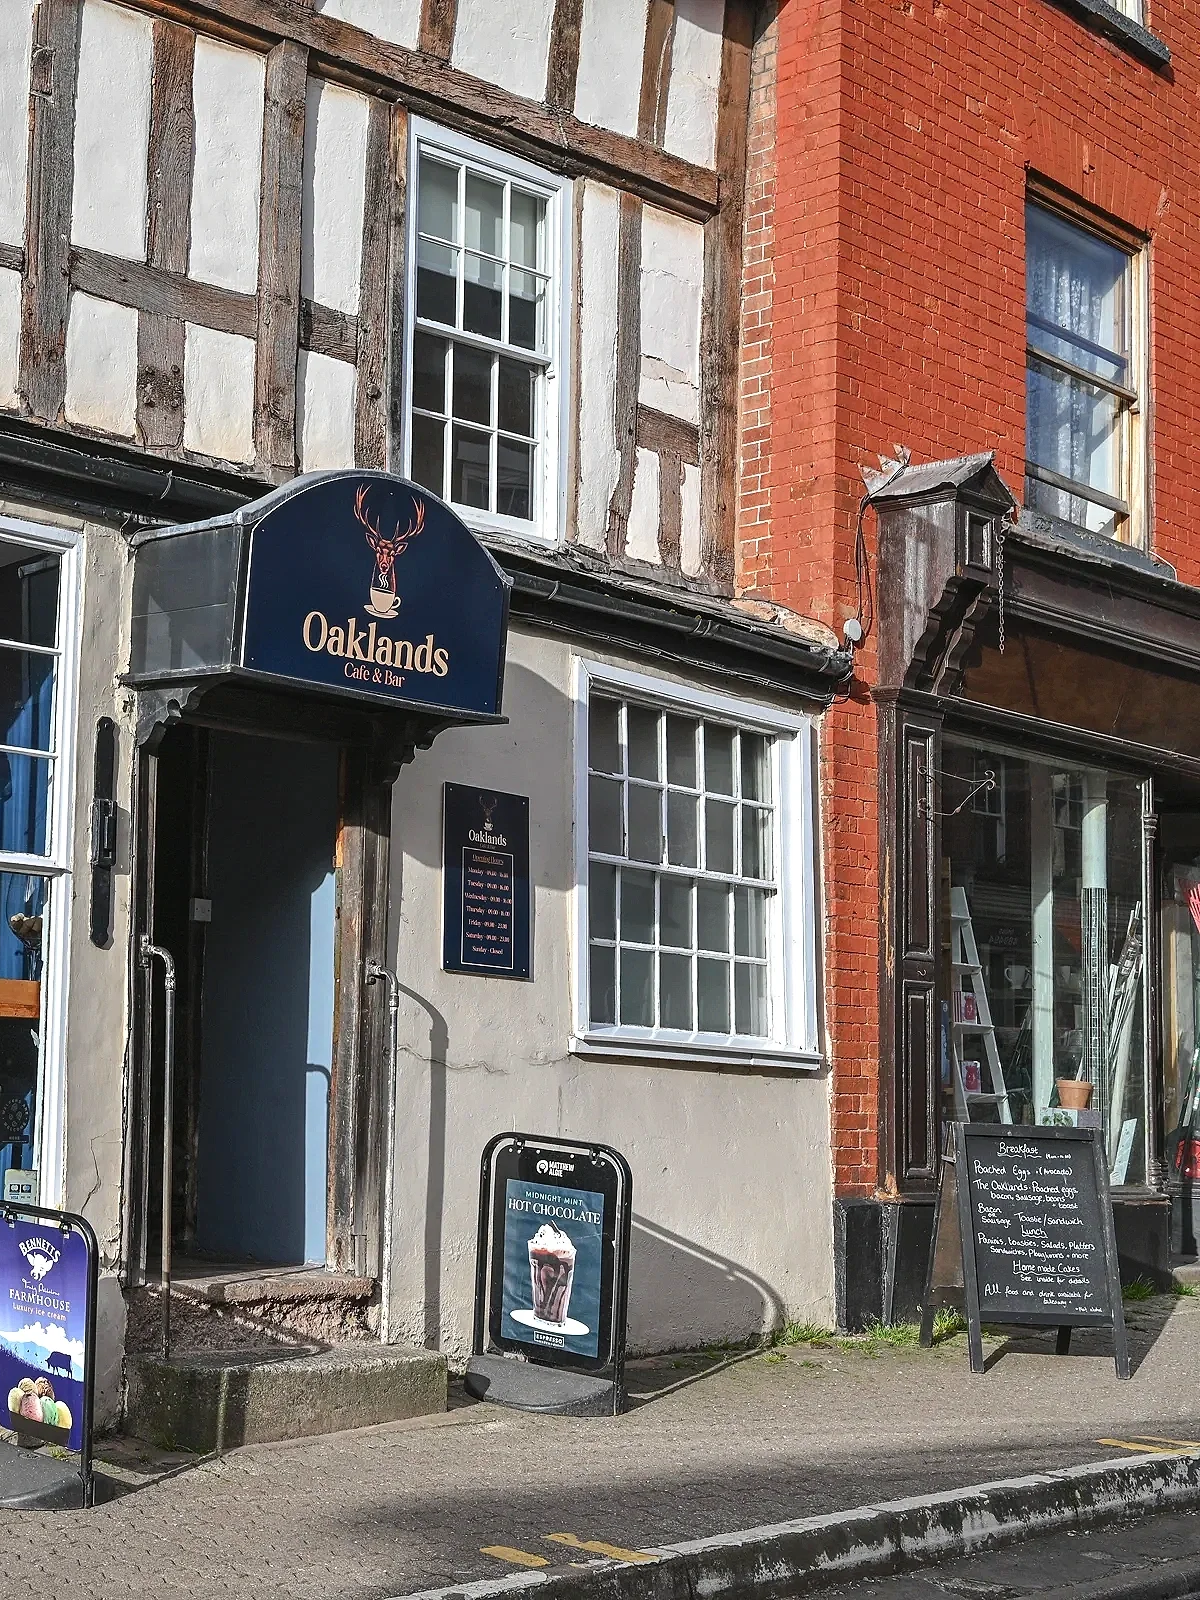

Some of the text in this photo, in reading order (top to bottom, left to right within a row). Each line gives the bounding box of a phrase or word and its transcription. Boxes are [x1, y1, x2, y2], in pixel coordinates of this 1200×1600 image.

[302, 611, 448, 676] Oaklands
[344, 662, 405, 687] Cafe & Bar
[469, 829, 507, 846] Oaklands
[468, 867, 483, 876] Monday
[468, 880, 483, 888] Tuesday
[465, 892, 487, 902] Wednesday
[466, 906, 484, 915] Thursday
[469, 919, 481, 927] Friday
[466, 932, 483, 940] Saturday
[472, 946, 487, 954] Sunday
[999, 1142, 1039, 1158] Breakfast
[549, 1161, 574, 1171] MATTHEW
[974, 1160, 1006, 1174] Poached
[1013, 1165, 1031, 1181] Eggs
[973, 1179, 989, 1190] The
[991, 1180, 1028, 1191] Oaklands
[1032, 1181, 1060, 1193] Poached
[526, 1191, 582, 1206] MIDNIGHT MINT
[509, 1198, 600, 1224] HOT CHOCOLATE
[978, 1203, 1002, 1213] Bacon
[981, 1216, 1011, 1228] Sausage
[1021, 1225, 1047, 1236] Lunch
[19, 1238, 60, 1262] BENNETTS
[1013, 1260, 1035, 1271] Home
[1058, 1263, 1080, 1272] Cakes
[1057, 1277, 1065, 1285] for
[984, 1283, 1001, 1296] All
[1005, 1286, 1019, 1297] food
[1084, 1291, 1093, 1299] for
[10, 1289, 70, 1312] FARMHOUSE
[13, 1303, 66, 1321] Luxury ice cream
[536, 1334, 562, 1344] ESPRESSO
